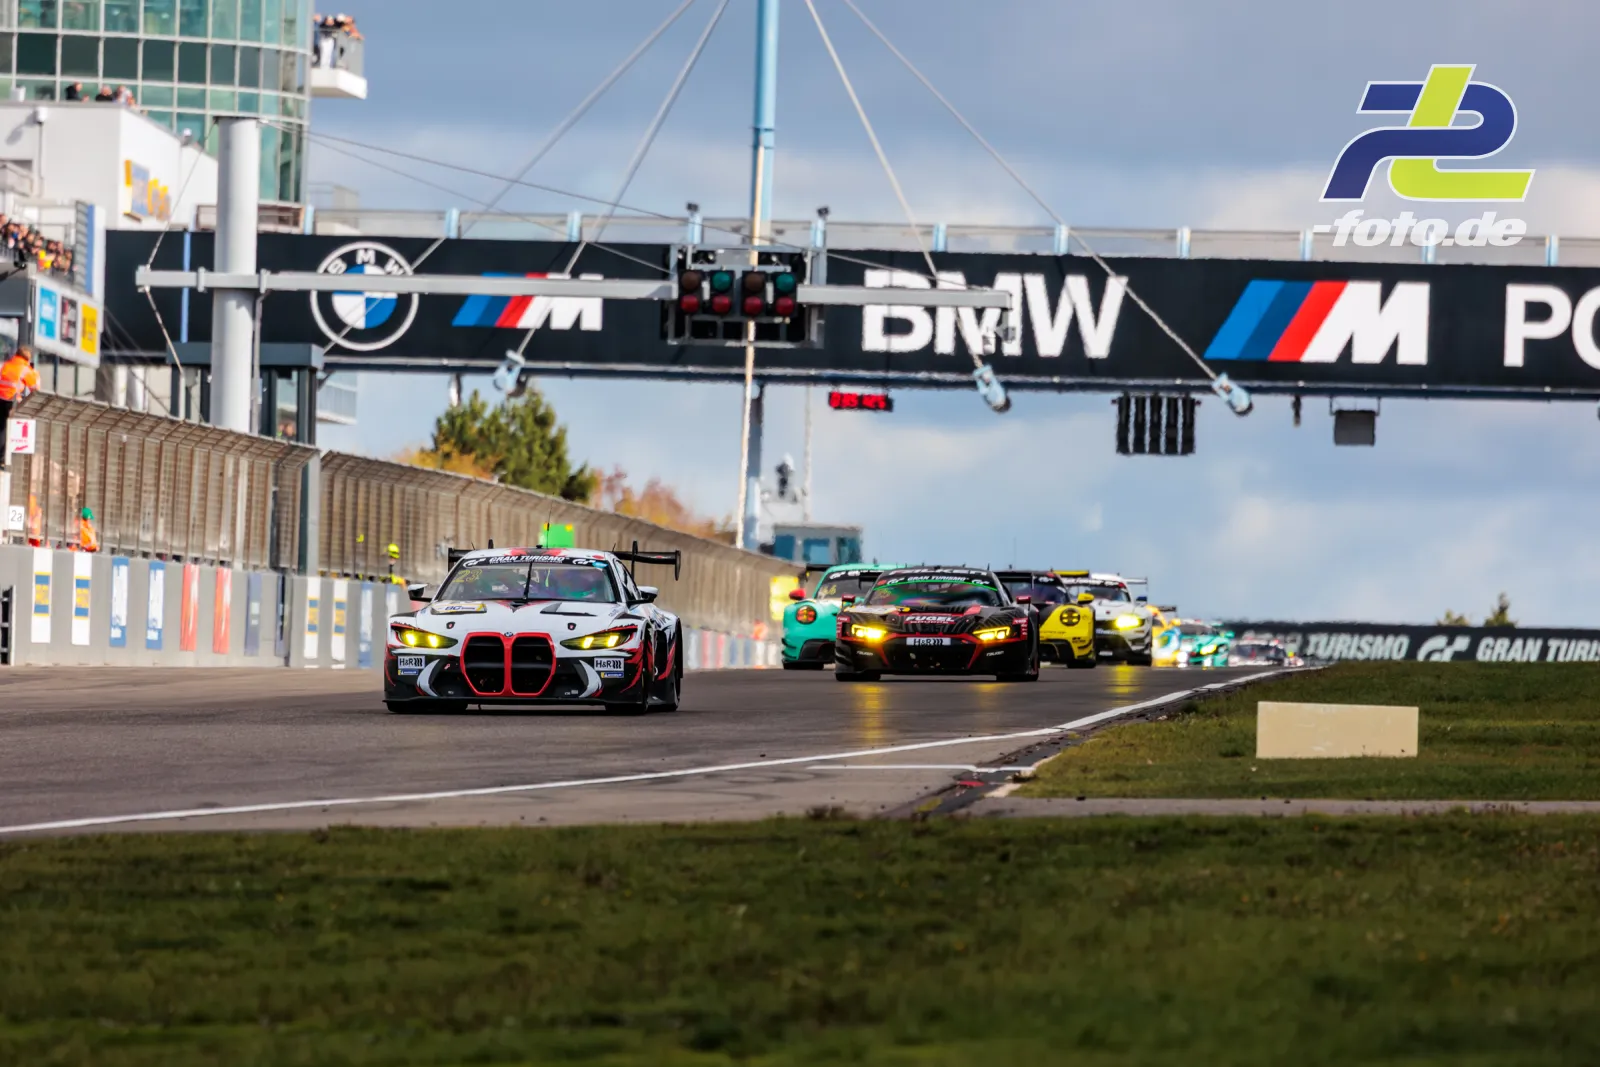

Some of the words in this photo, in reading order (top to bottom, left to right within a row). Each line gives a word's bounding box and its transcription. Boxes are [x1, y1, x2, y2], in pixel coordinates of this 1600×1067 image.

[327, 249, 405, 275] BMW
[862, 269, 1129, 359] BMW
[1300, 280, 1430, 365] M
[489, 555, 518, 563] GRAN
[519, 555, 565, 563] TURISMO
[1306, 632, 1410, 661] TURISMO
[1476, 635, 1543, 662] GRAN
[1546, 637, 1600, 662] TURI
[399, 657, 414, 667] H&R
[595, 659, 612, 669] H&R
